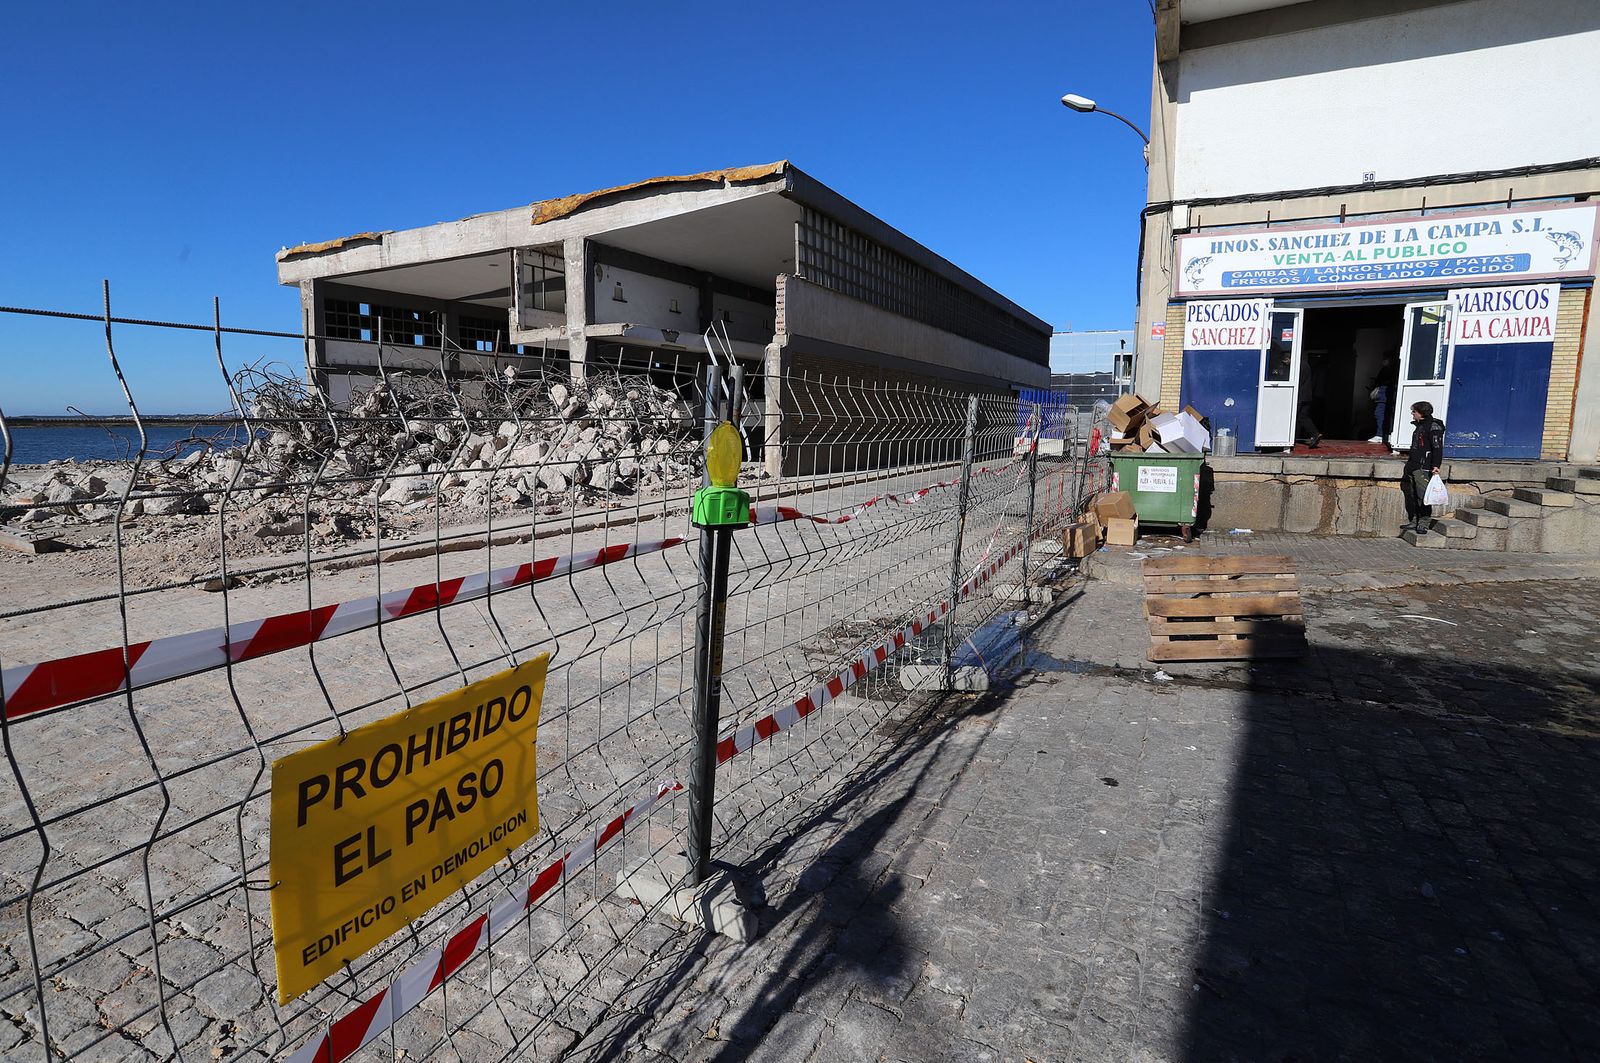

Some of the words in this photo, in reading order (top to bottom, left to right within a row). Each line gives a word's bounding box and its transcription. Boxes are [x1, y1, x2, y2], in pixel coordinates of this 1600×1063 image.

[1364, 173, 1374, 181] 50
[1210, 238, 1264, 254] HNOS.
[1268, 232, 1351, 251] SANCHEZ
[1359, 230, 1386, 245] DE
[1394, 227, 1419, 243] LA
[1427, 221, 1502, 240] CAMPA
[1512, 217, 1553, 233] S.L.
[1273, 251, 1336, 266] VENTA
[1342, 249, 1367, 262] AL
[1373, 241, 1468, 260] PUBLICO
[1230, 276, 1301, 286] FRESCOS
[1317, 270, 1425, 283] CONGELADO
[1440, 264, 1515, 275] COCIDO
[1231, 268, 1299, 279] GAMBAS
[1313, 260, 1440, 275] LANGOSTINOS
[1456, 255, 1515, 266] PATAS
[1455, 288, 1550, 313] MARISCOS
[1187, 303, 1260, 323] PESCADOS
[1191, 327, 1256, 346] SANCHEZ
[1461, 319, 1482, 339] LA
[1488, 316, 1551, 339] CAMPA
[297, 684, 532, 828] PROHIBIDO
[334, 825, 392, 888] EL
[406, 758, 504, 846] PASO
[302, 896, 396, 967] EDIFICIO
[402, 874, 427, 904] EN
[431, 809, 528, 884] DEMOLICION
